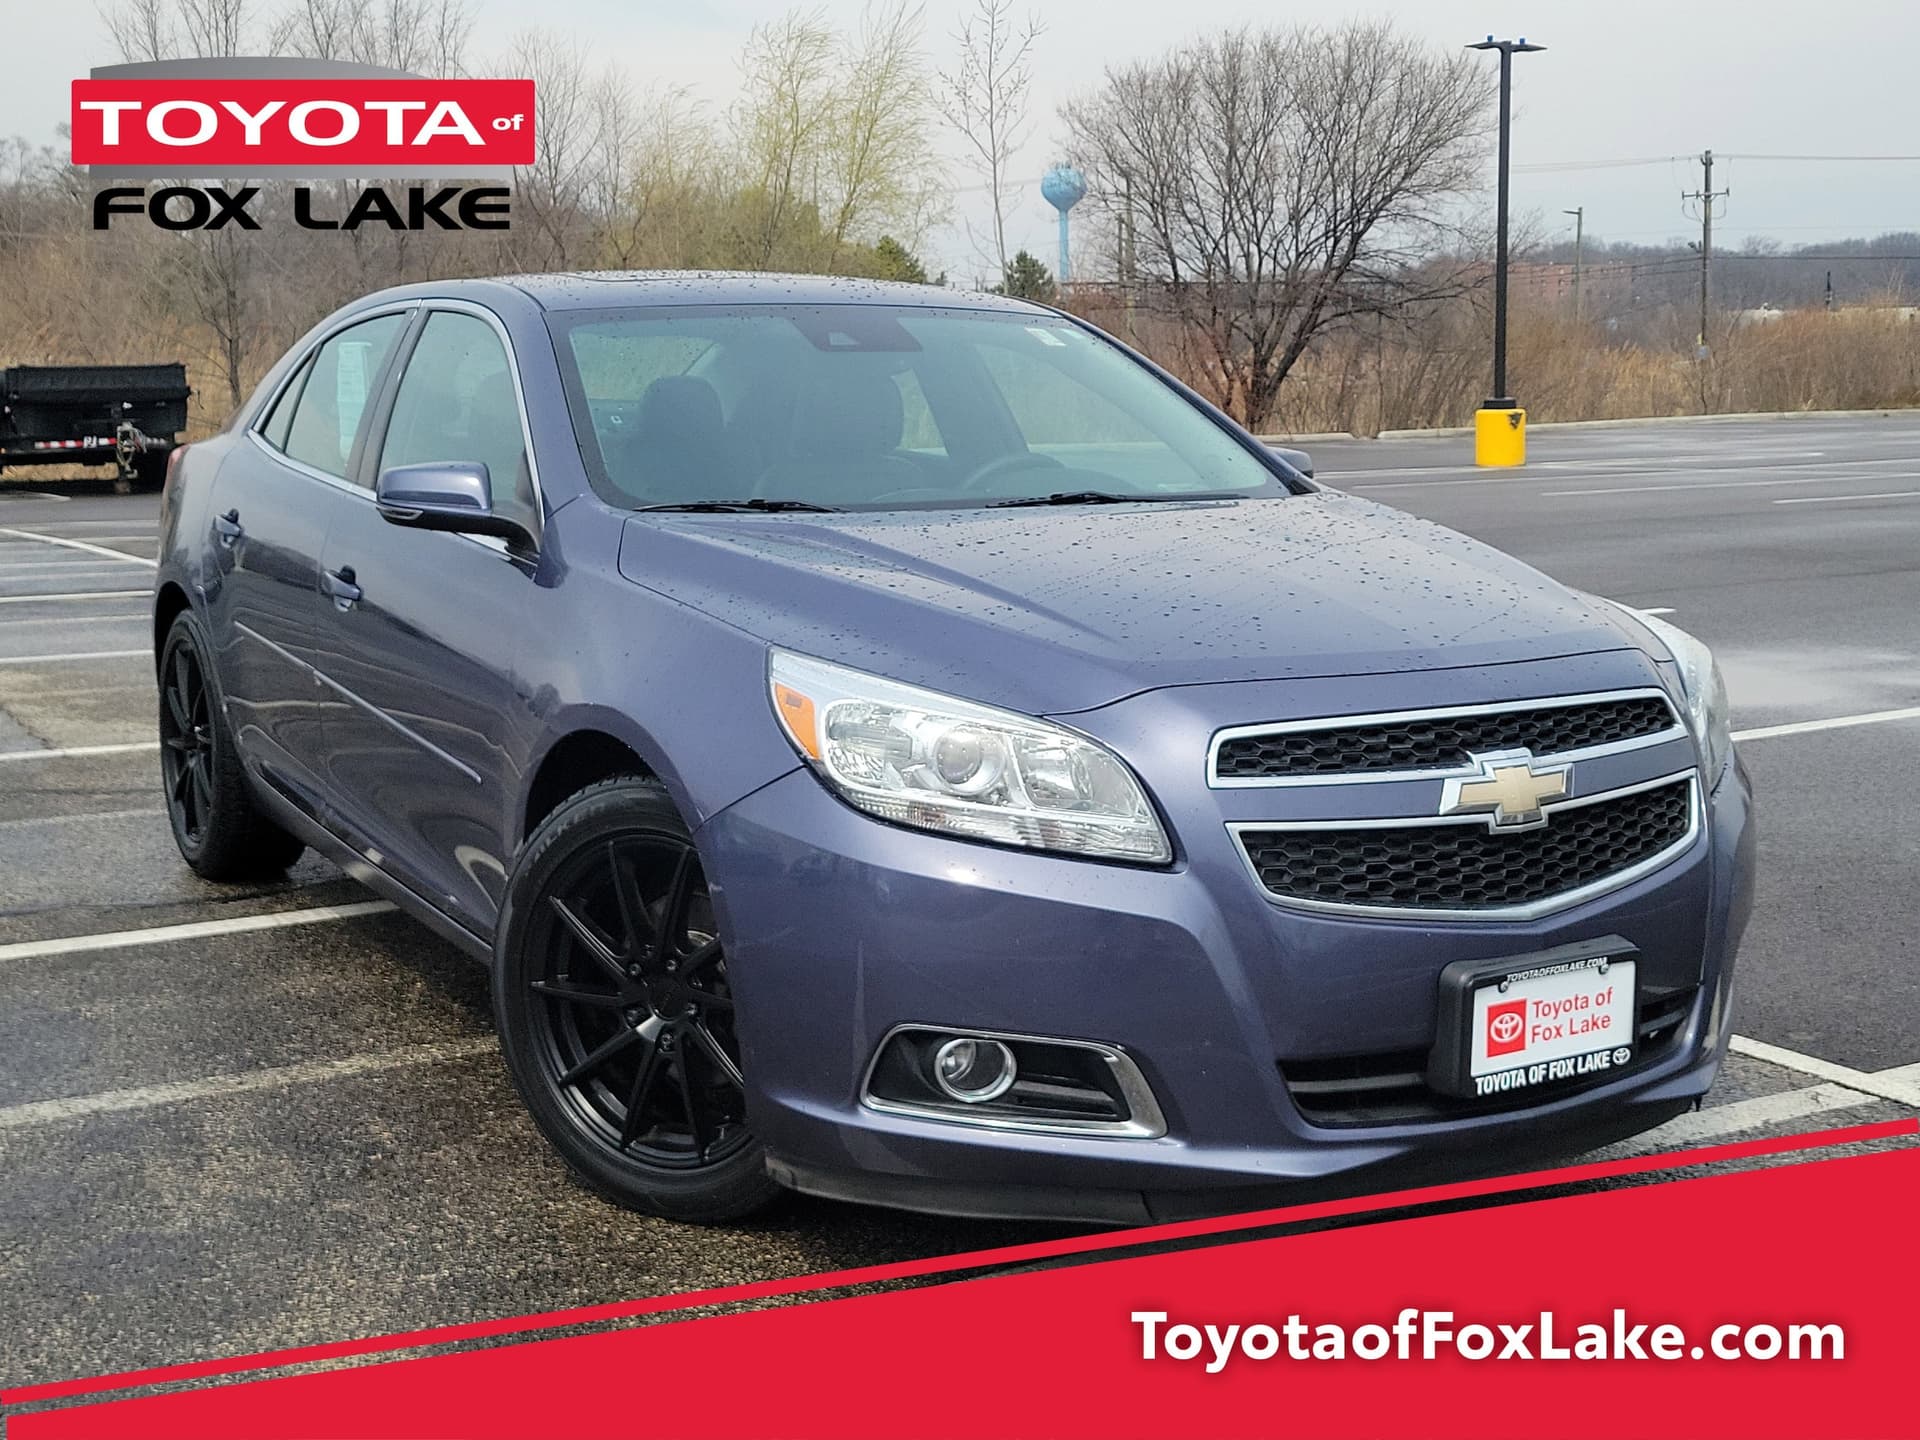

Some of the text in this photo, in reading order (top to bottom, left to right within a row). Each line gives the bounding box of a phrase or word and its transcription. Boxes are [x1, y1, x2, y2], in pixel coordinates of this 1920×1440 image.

[1506, 957, 1608, 983] TOYOTAOFFOXLAKE.COM
[1532, 986, 1613, 1021] Toyota of
[1531, 1013, 1612, 1044] Fox Lake
[1475, 1050, 1611, 1096] TOYOTA OF FOX LAKE
